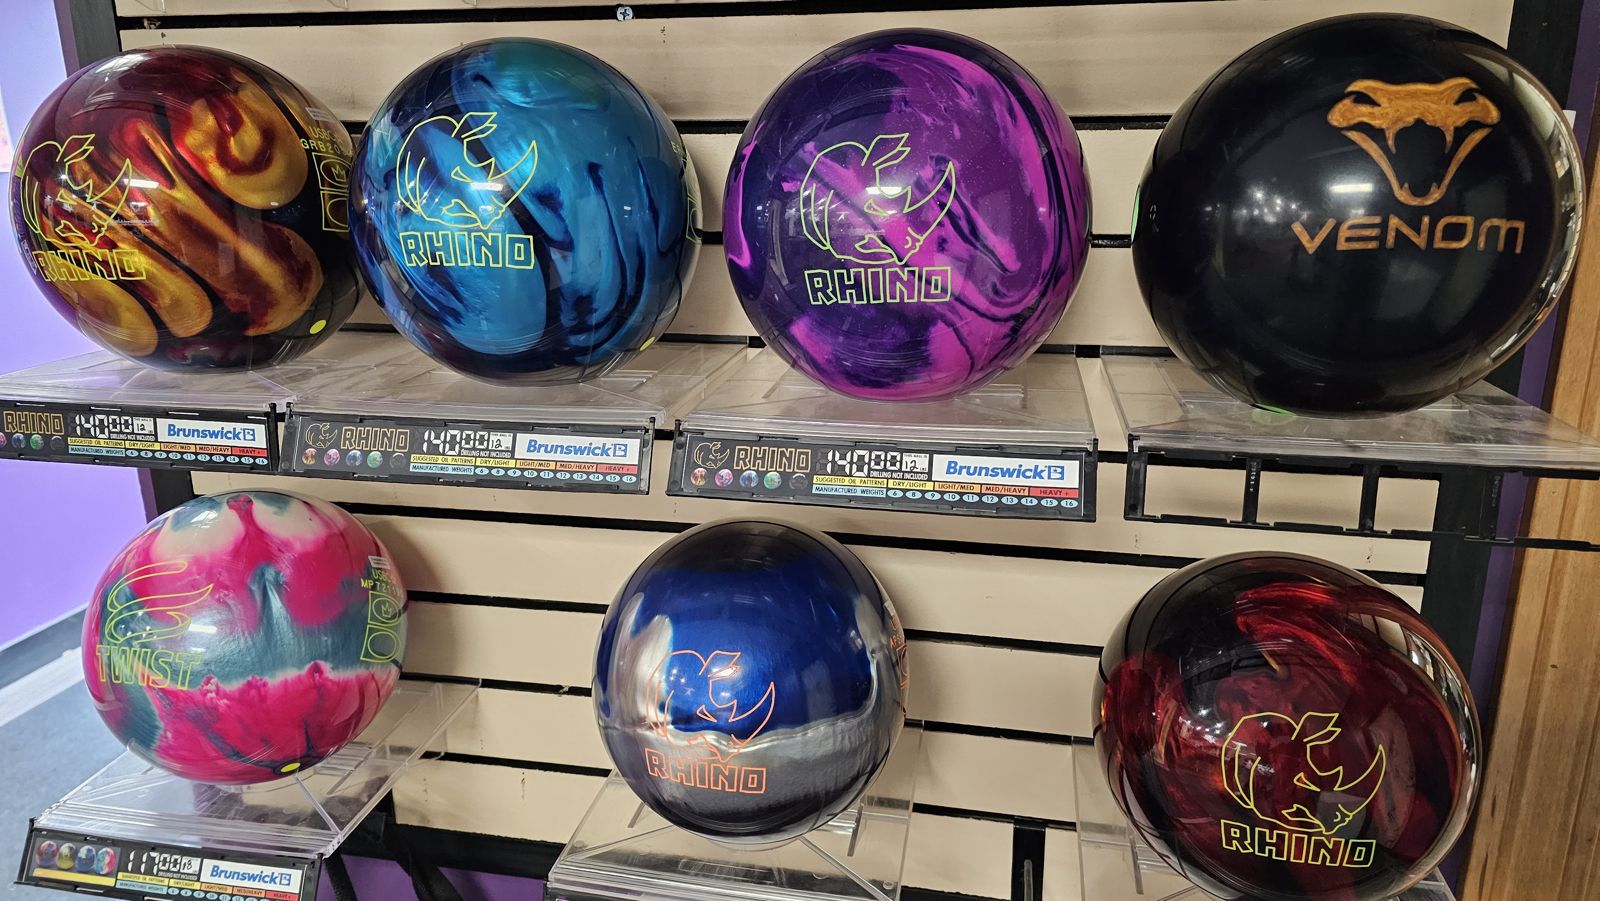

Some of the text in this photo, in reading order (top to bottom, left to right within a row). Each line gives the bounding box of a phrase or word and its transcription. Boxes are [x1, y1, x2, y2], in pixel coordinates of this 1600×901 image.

[1291, 213, 1525, 254] VENOM
[400, 231, 535, 269] RHINO
[32, 249, 146, 281] RHINO
[804, 266, 951, 305] RHINO
[4, 411, 64, 435] RHINO
[168, 424, 241, 440] Brunswick
[341, 426, 410, 452] RHINO
[526, 439, 611, 456] Brunswick
[734, 446, 811, 472] RHINO
[905, 460, 918, 471] 12
[946, 461, 1045, 479] Brunswick
[815, 486, 858, 494] MANUFACTURED
[96, 645, 204, 690] TWIST
[645, 747, 766, 794] RHINO
[1221, 819, 1376, 867] RHINO
[210, 865, 278, 885] Brunswick
